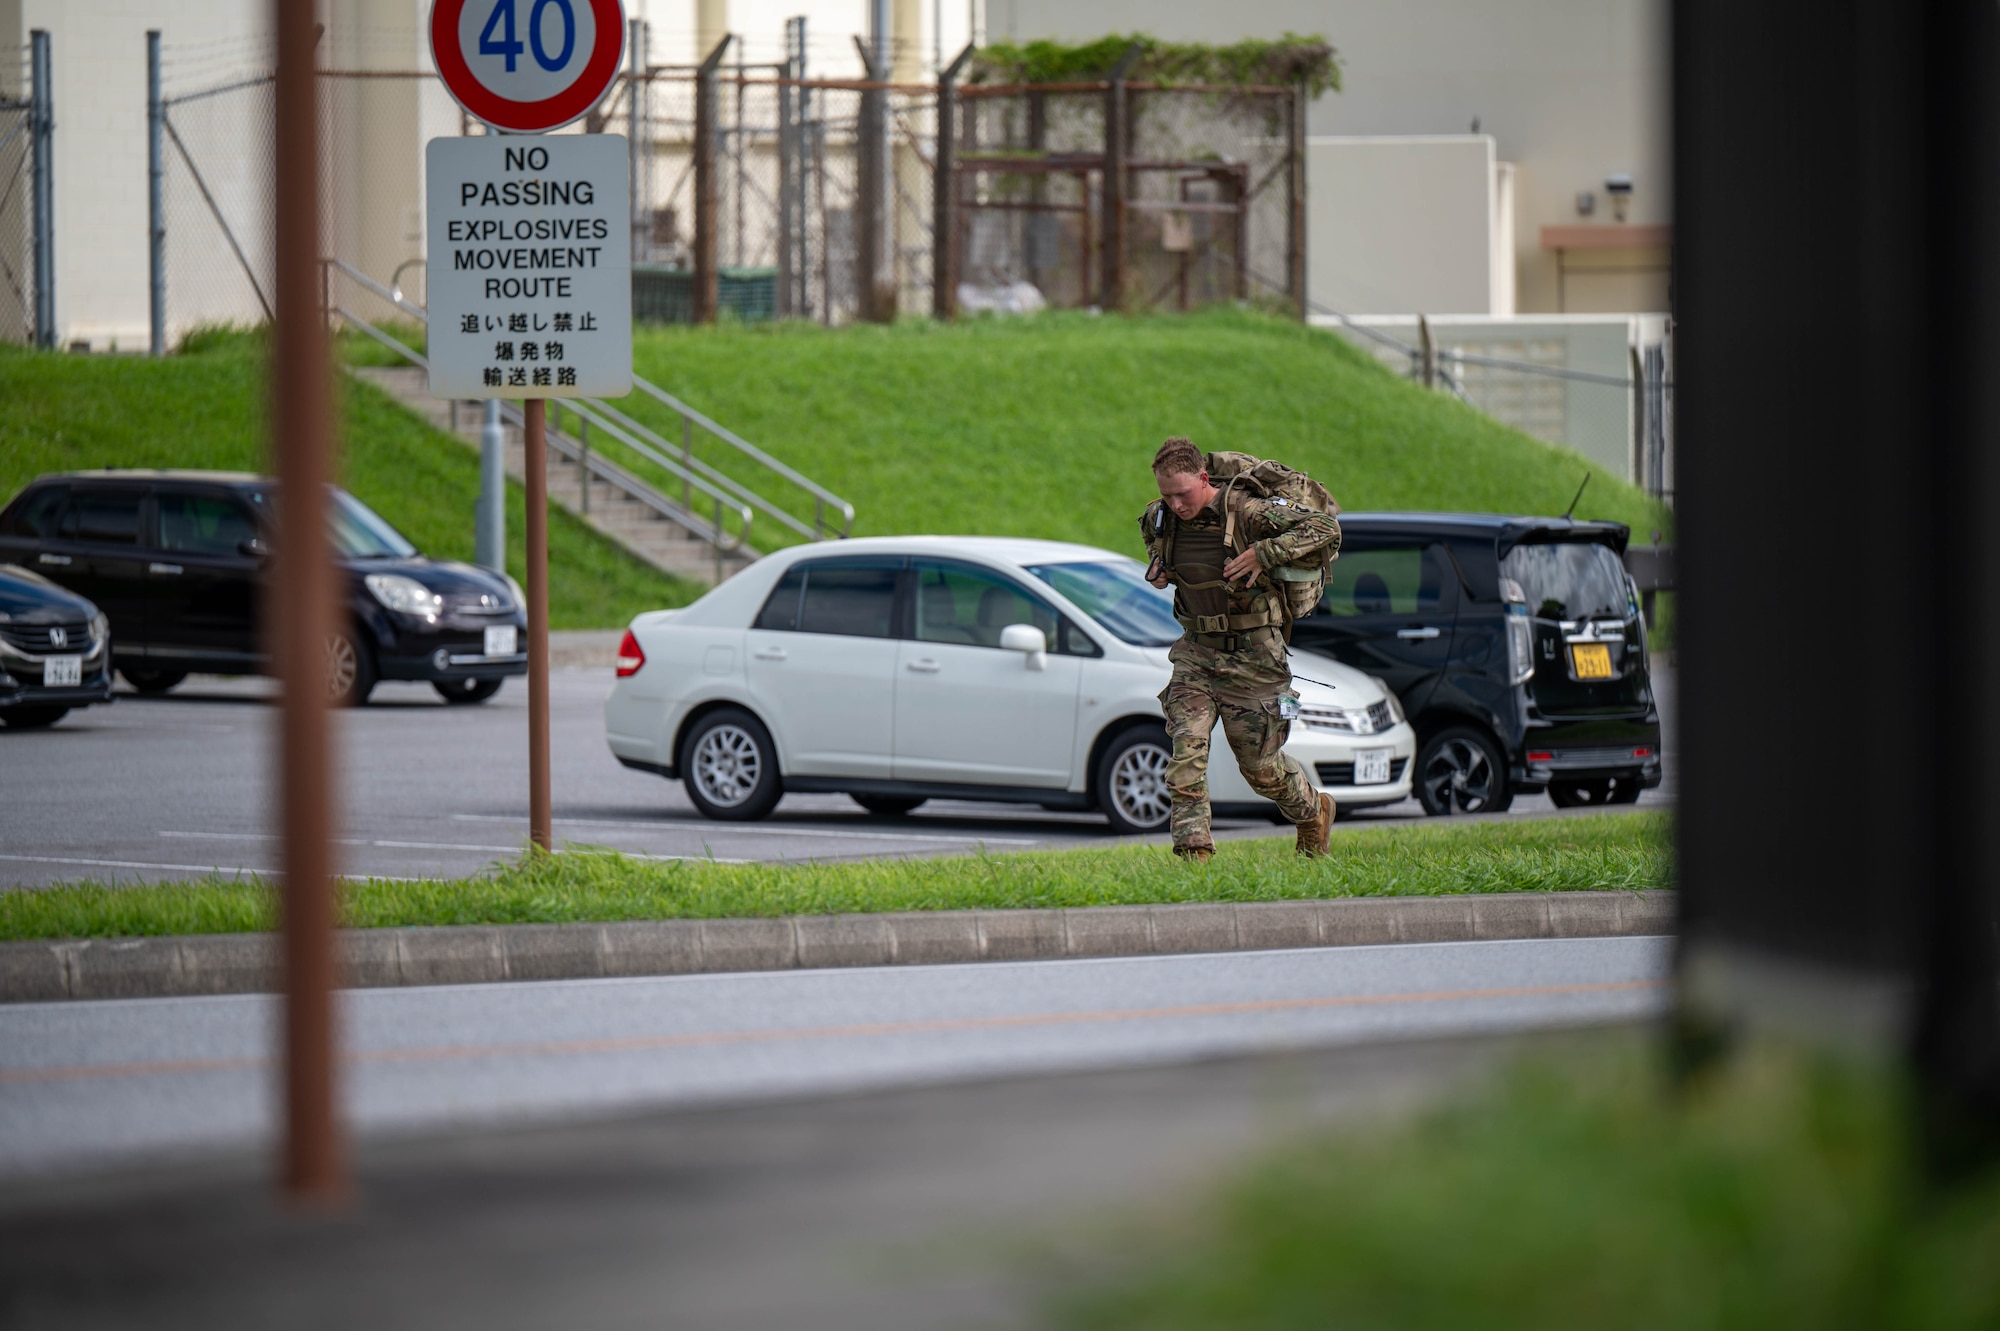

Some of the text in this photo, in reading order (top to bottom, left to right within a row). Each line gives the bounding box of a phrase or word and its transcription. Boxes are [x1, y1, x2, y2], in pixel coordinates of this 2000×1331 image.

[478, 0, 576, 73] 40
[504, 146, 549, 172] NO
[461, 180, 594, 207] PASSING
[447, 218, 608, 242] EXPLOSIVES
[454, 247, 602, 271] MOVEMENT
[485, 277, 572, 299] ROUTE
[460, 312, 598, 334] 追い越し禁止
[495, 341, 564, 362] 爆発物
[483, 366, 577, 388] 輸送経路
